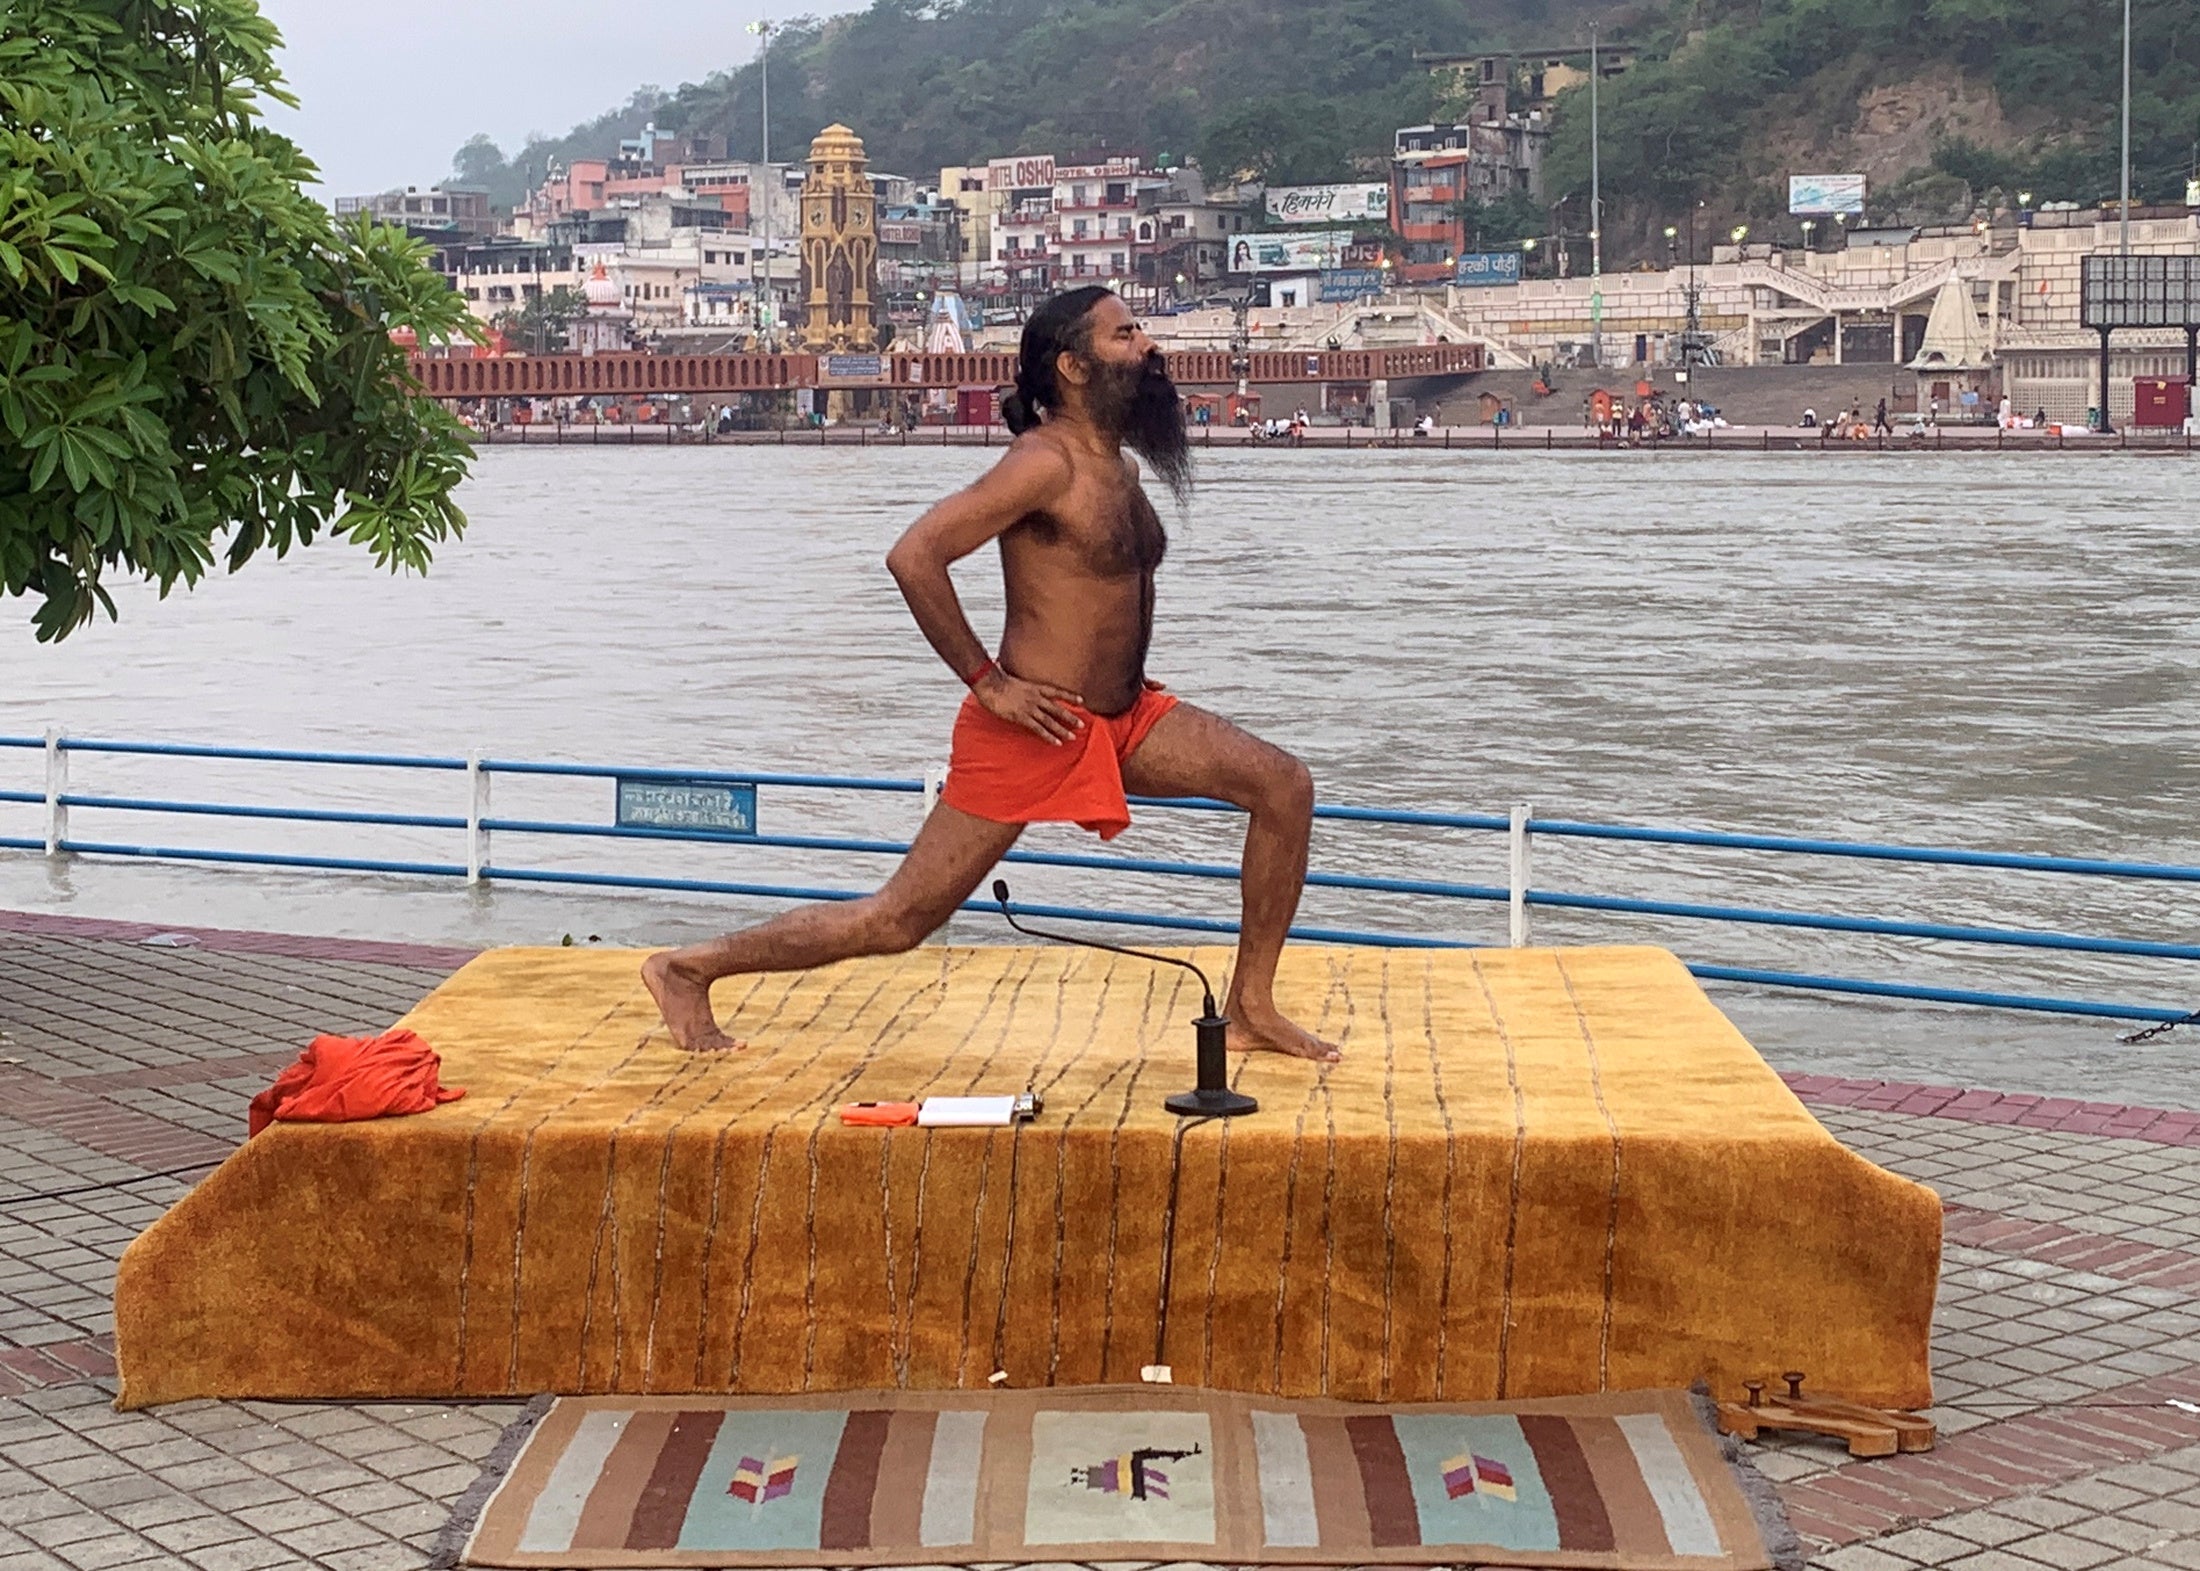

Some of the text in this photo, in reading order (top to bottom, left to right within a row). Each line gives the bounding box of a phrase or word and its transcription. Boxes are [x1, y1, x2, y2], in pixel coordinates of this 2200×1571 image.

[989, 159, 1054, 187] HOTEL OSHO
[1055, 165, 1128, 177] HOTEL OSHO
[1458, 254, 1517, 277] हरकी पौड़ी
